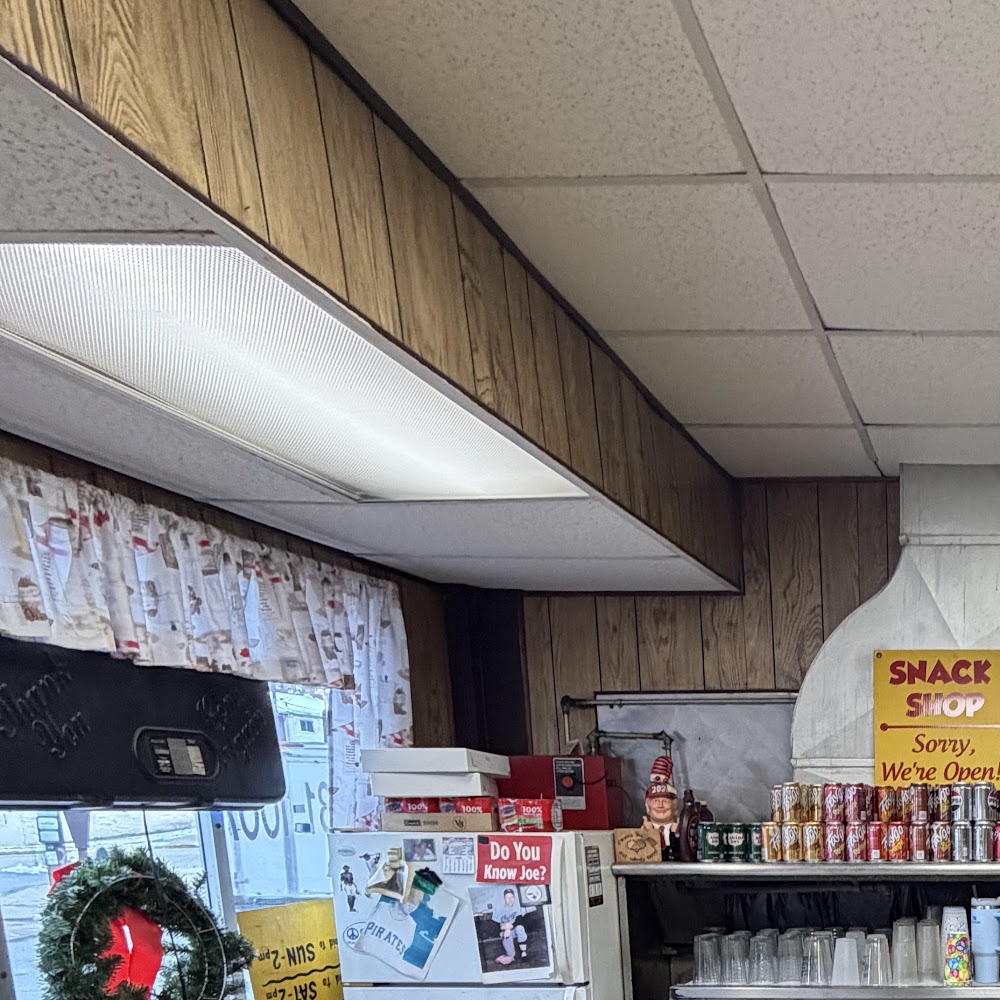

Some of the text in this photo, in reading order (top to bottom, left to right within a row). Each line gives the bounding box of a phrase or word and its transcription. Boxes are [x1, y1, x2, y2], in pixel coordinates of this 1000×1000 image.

[889, 659, 992, 685] SNACK
[906, 692, 985, 717] SHOP
[912, 733, 976, 757] Sorry,
[881, 761, 937, 782] We're
[407, 802, 429, 812] 100%
[461, 804, 483, 814] 100%
[521, 805, 543, 814] 100%
[489, 841, 541, 861] Do You
[483, 864, 547, 881] Know Joe?
[363, 921, 407, 956] PIRATES
